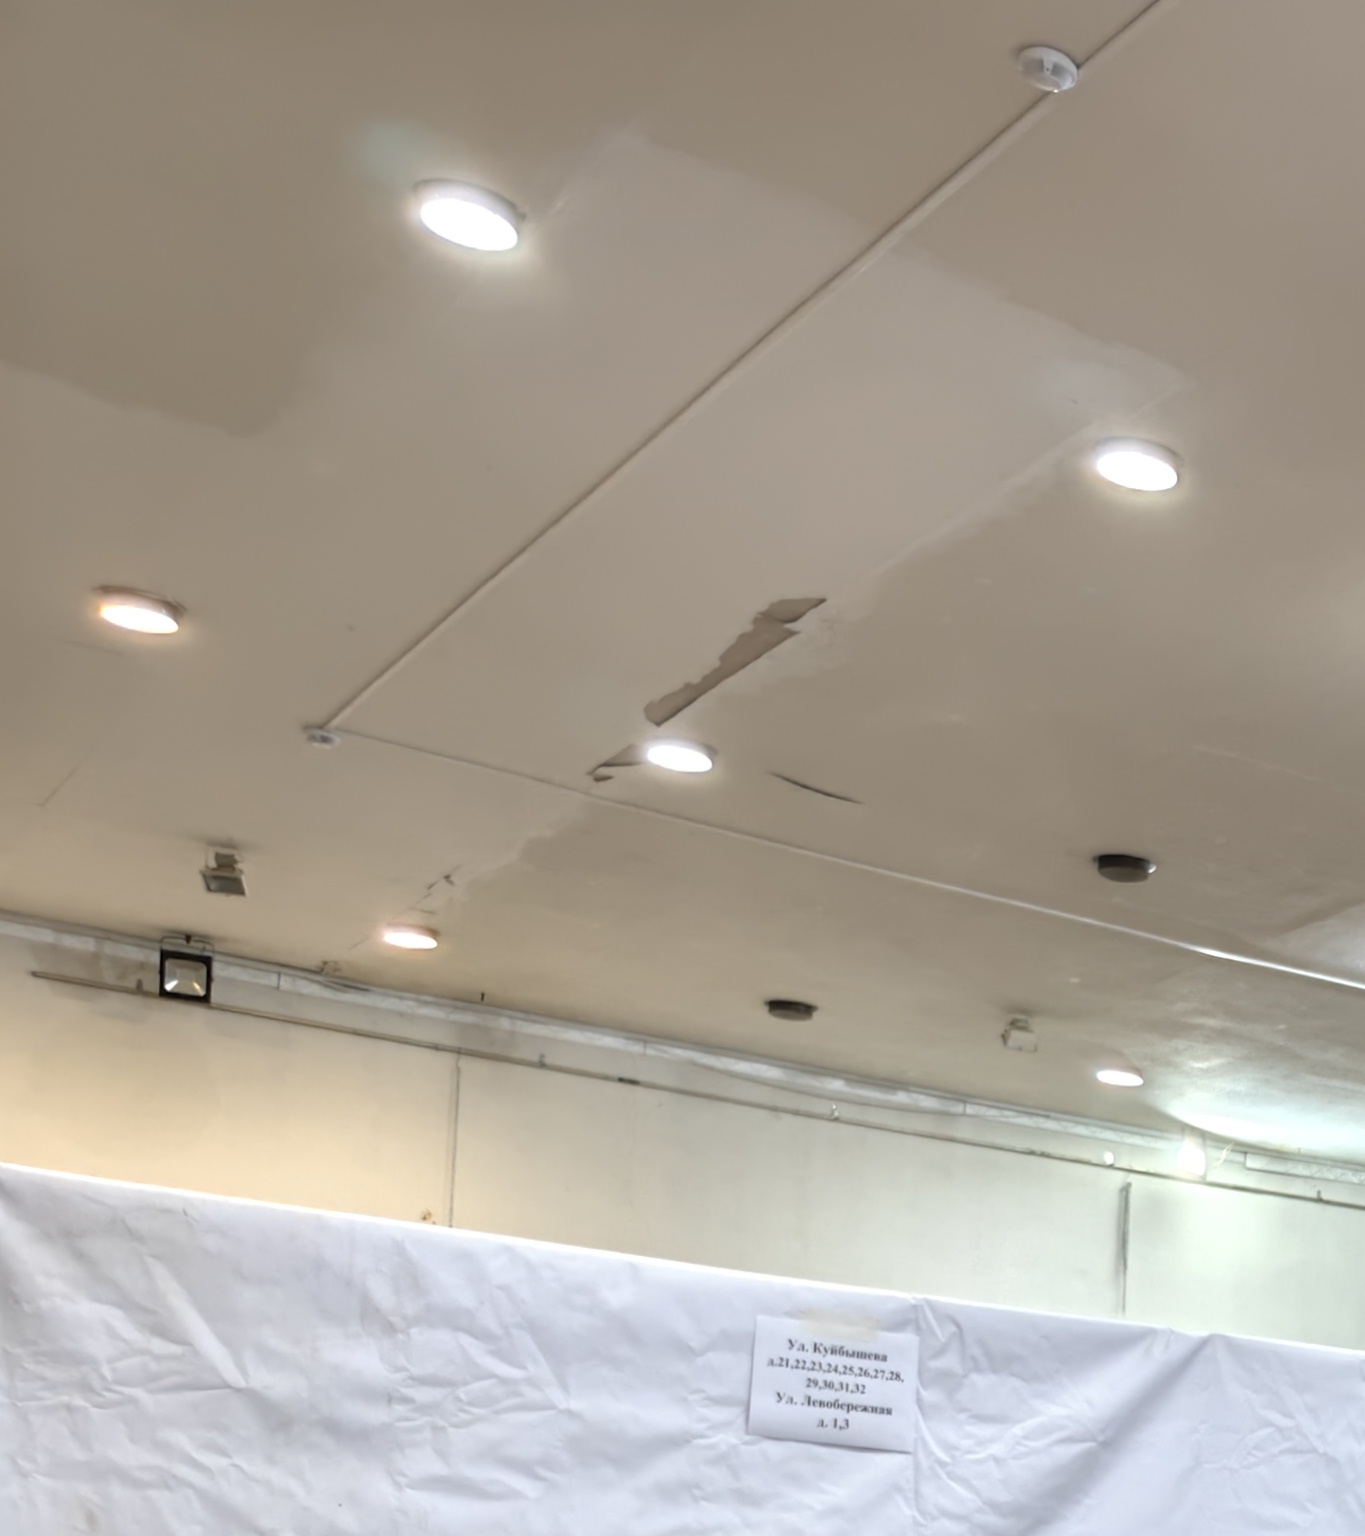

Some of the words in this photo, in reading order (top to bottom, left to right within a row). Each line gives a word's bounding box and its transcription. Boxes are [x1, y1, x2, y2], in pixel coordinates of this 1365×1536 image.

[788, 1338, 809, 1352] Ул.
[813, 1342, 888, 1362] Куйбышева
[805, 1377, 867, 1395] 29,30,31,32
[775, 1391, 798, 1405] Ул.
[801, 1395, 893, 1416] Левобережная
[832, 1417, 850, 1431] 1,3
